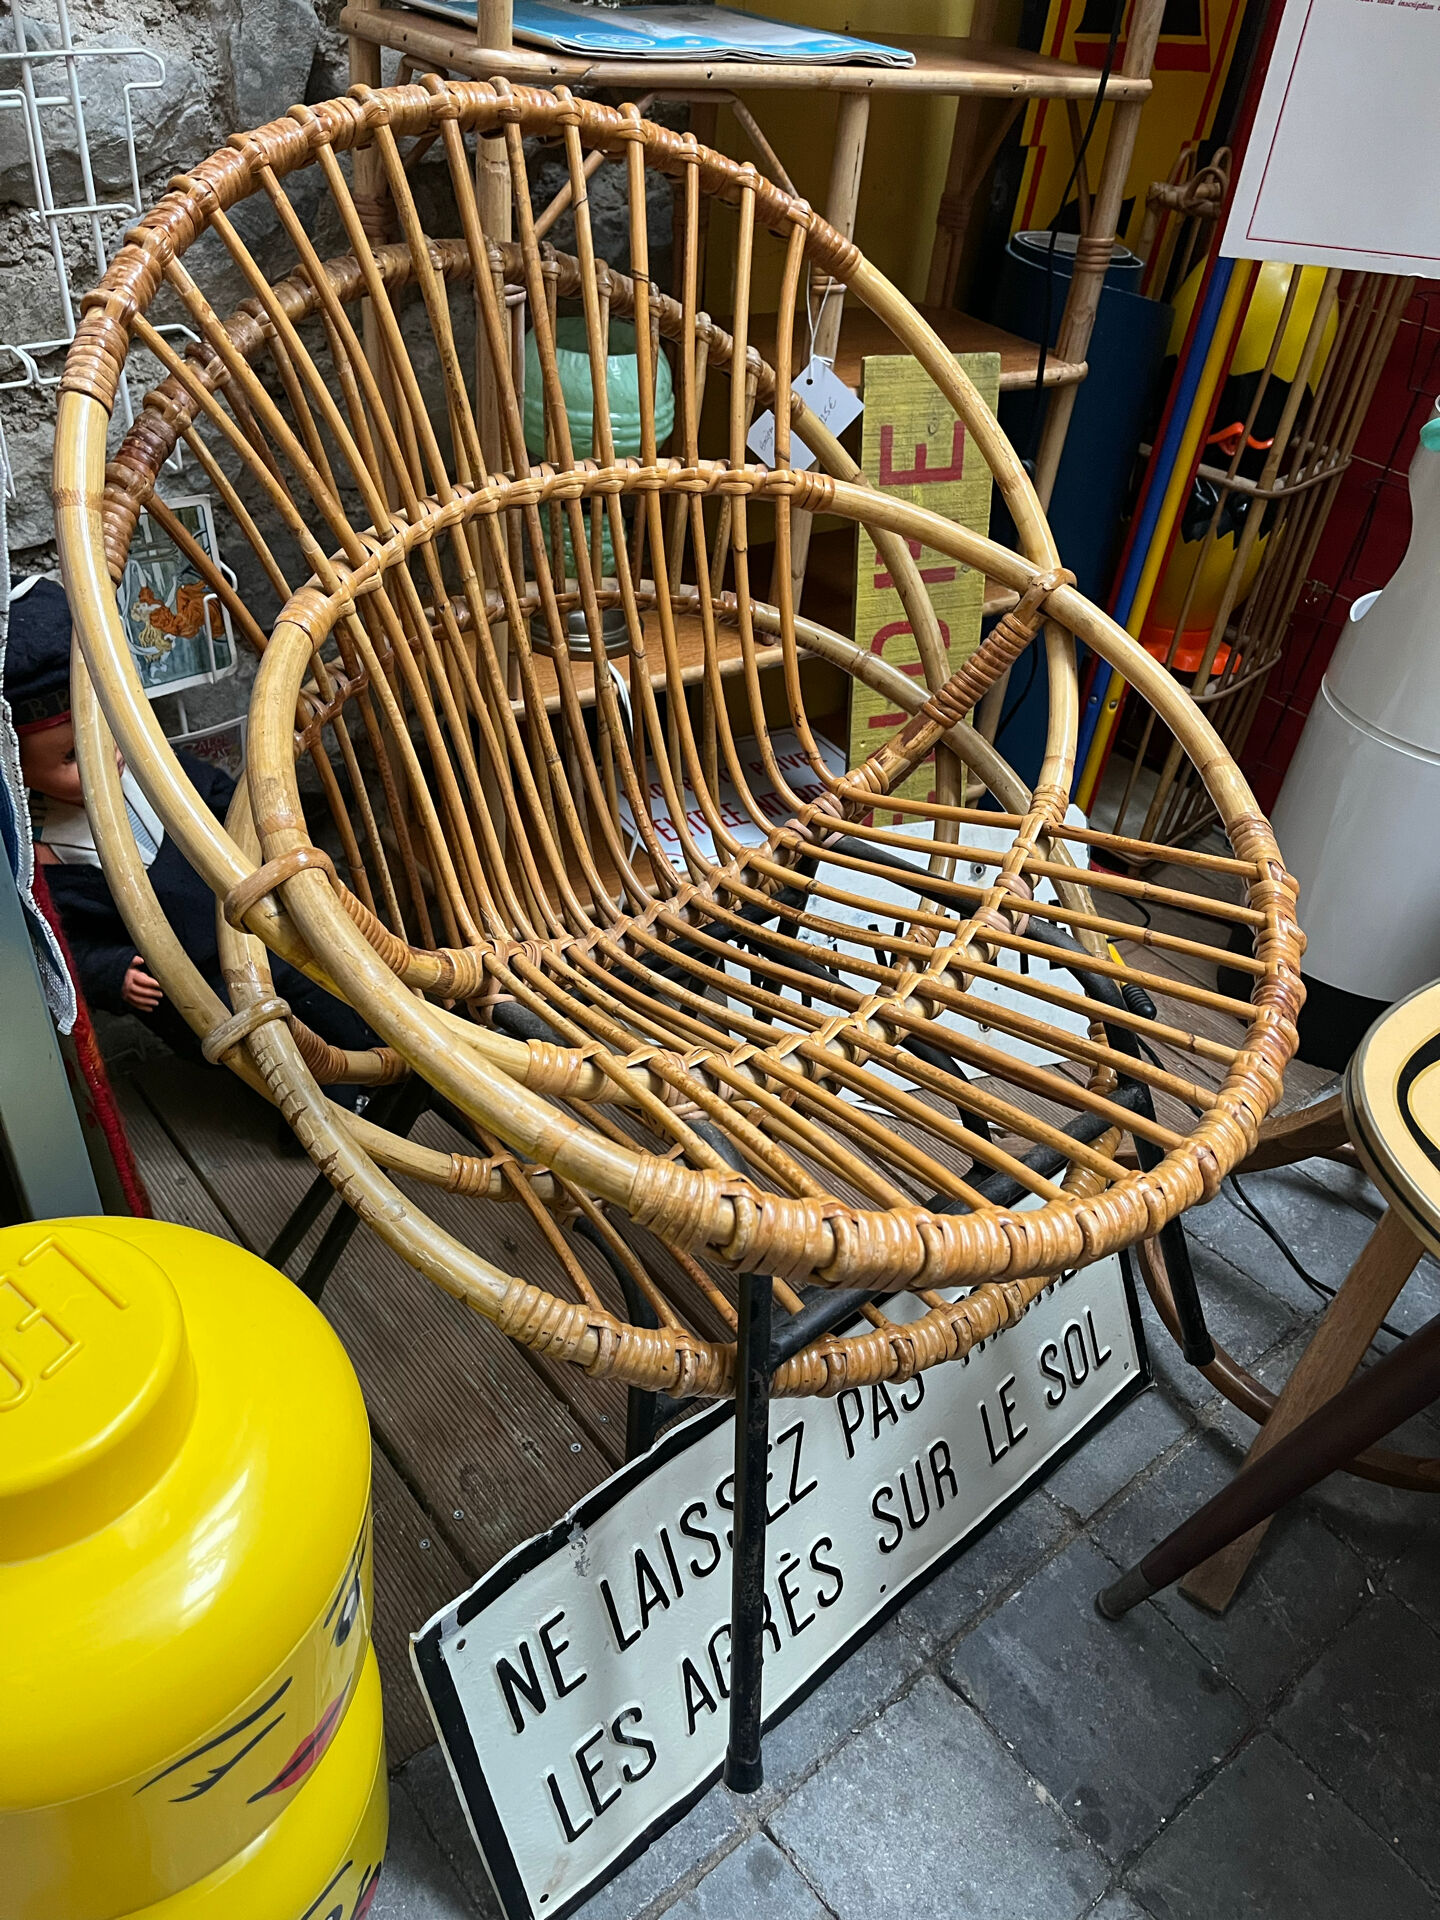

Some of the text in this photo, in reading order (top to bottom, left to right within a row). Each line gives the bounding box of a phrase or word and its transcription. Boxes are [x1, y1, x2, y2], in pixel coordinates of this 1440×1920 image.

[495, 1373, 925, 1734] NE LAISSEZ PAS
[547, 1706, 657, 1843] LES
[871, 1440, 958, 1554] SUR
[979, 1375, 1029, 1465] LE
[1040, 1310, 1112, 1406] SOL
